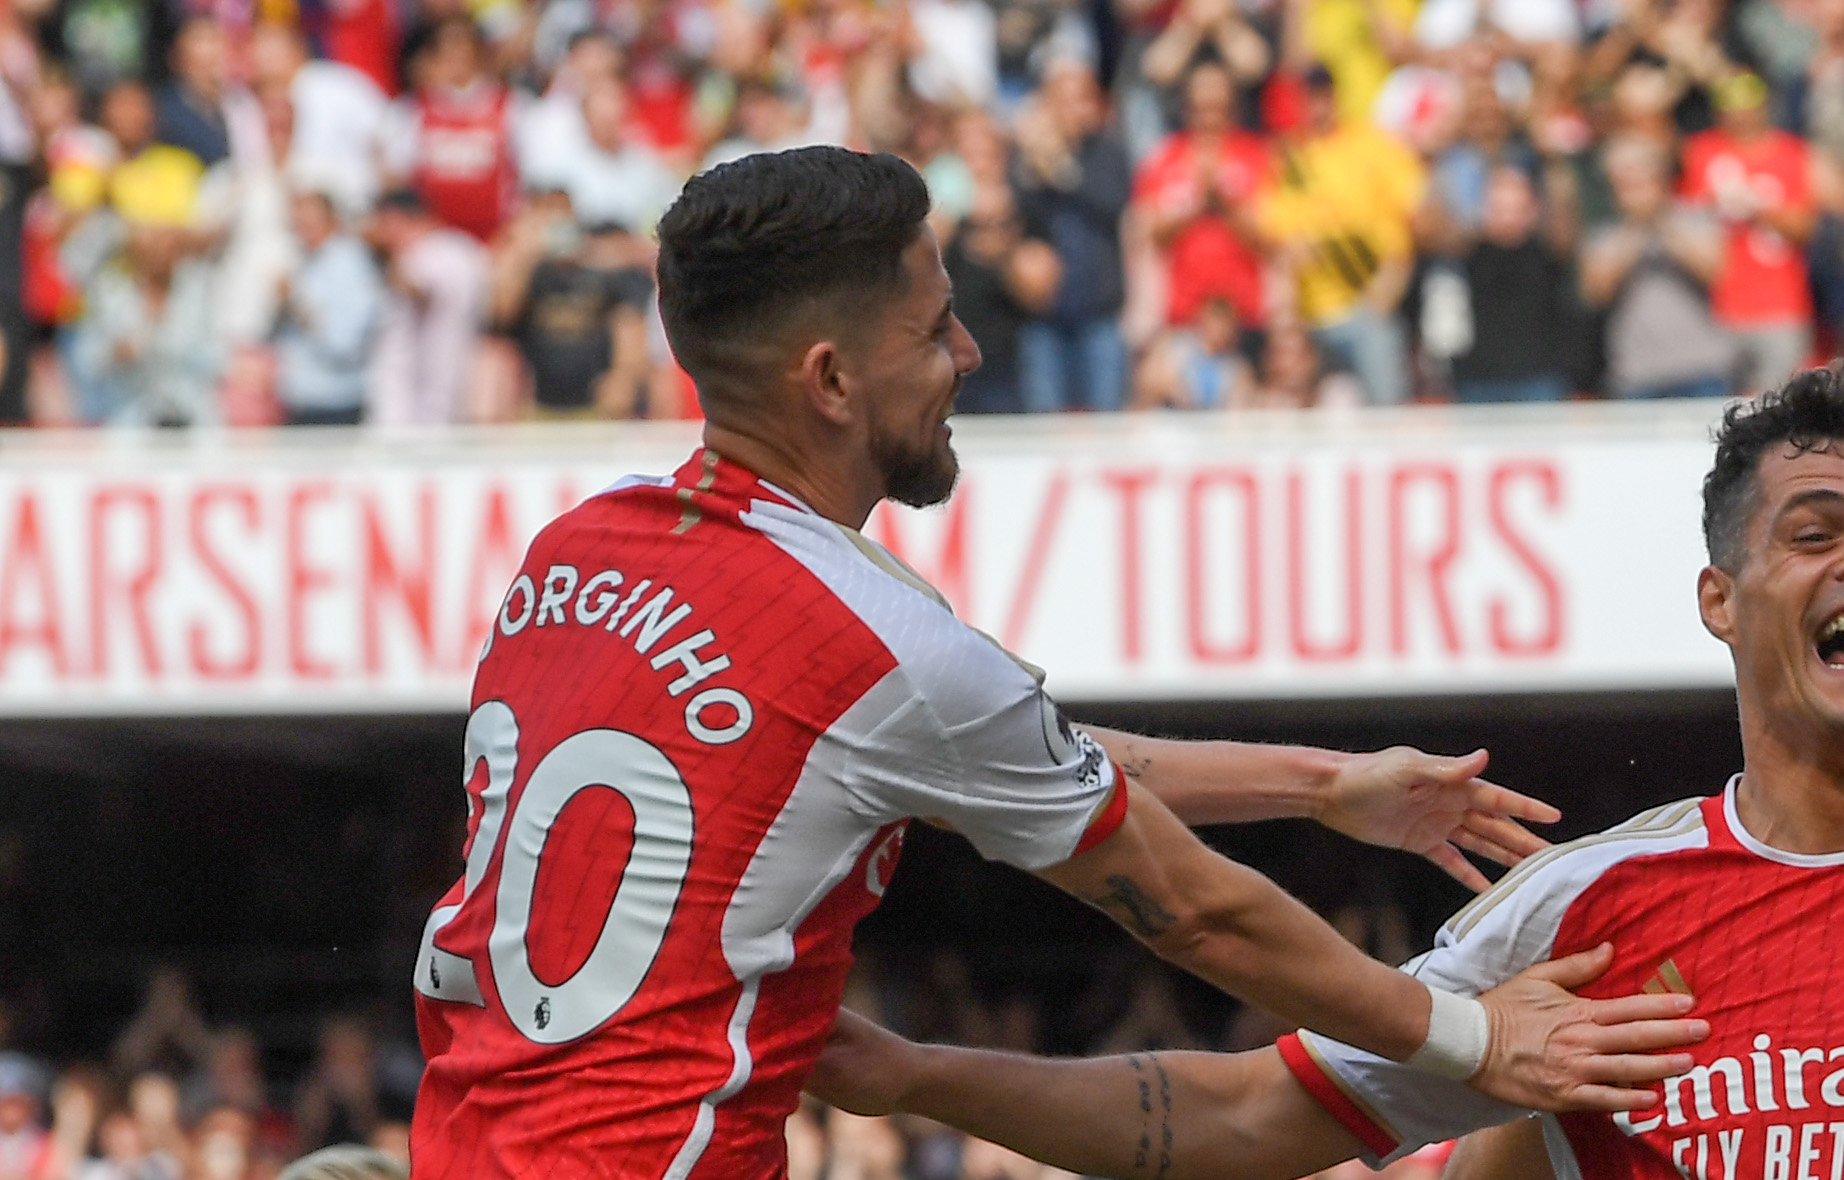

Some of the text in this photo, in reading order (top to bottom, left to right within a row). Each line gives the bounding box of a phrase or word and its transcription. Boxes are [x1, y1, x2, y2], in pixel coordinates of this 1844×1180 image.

[0, 484, 580, 672] ARSENA
[478, 565, 753, 744] ORGINHO
[413, 699, 695, 1044] 20
